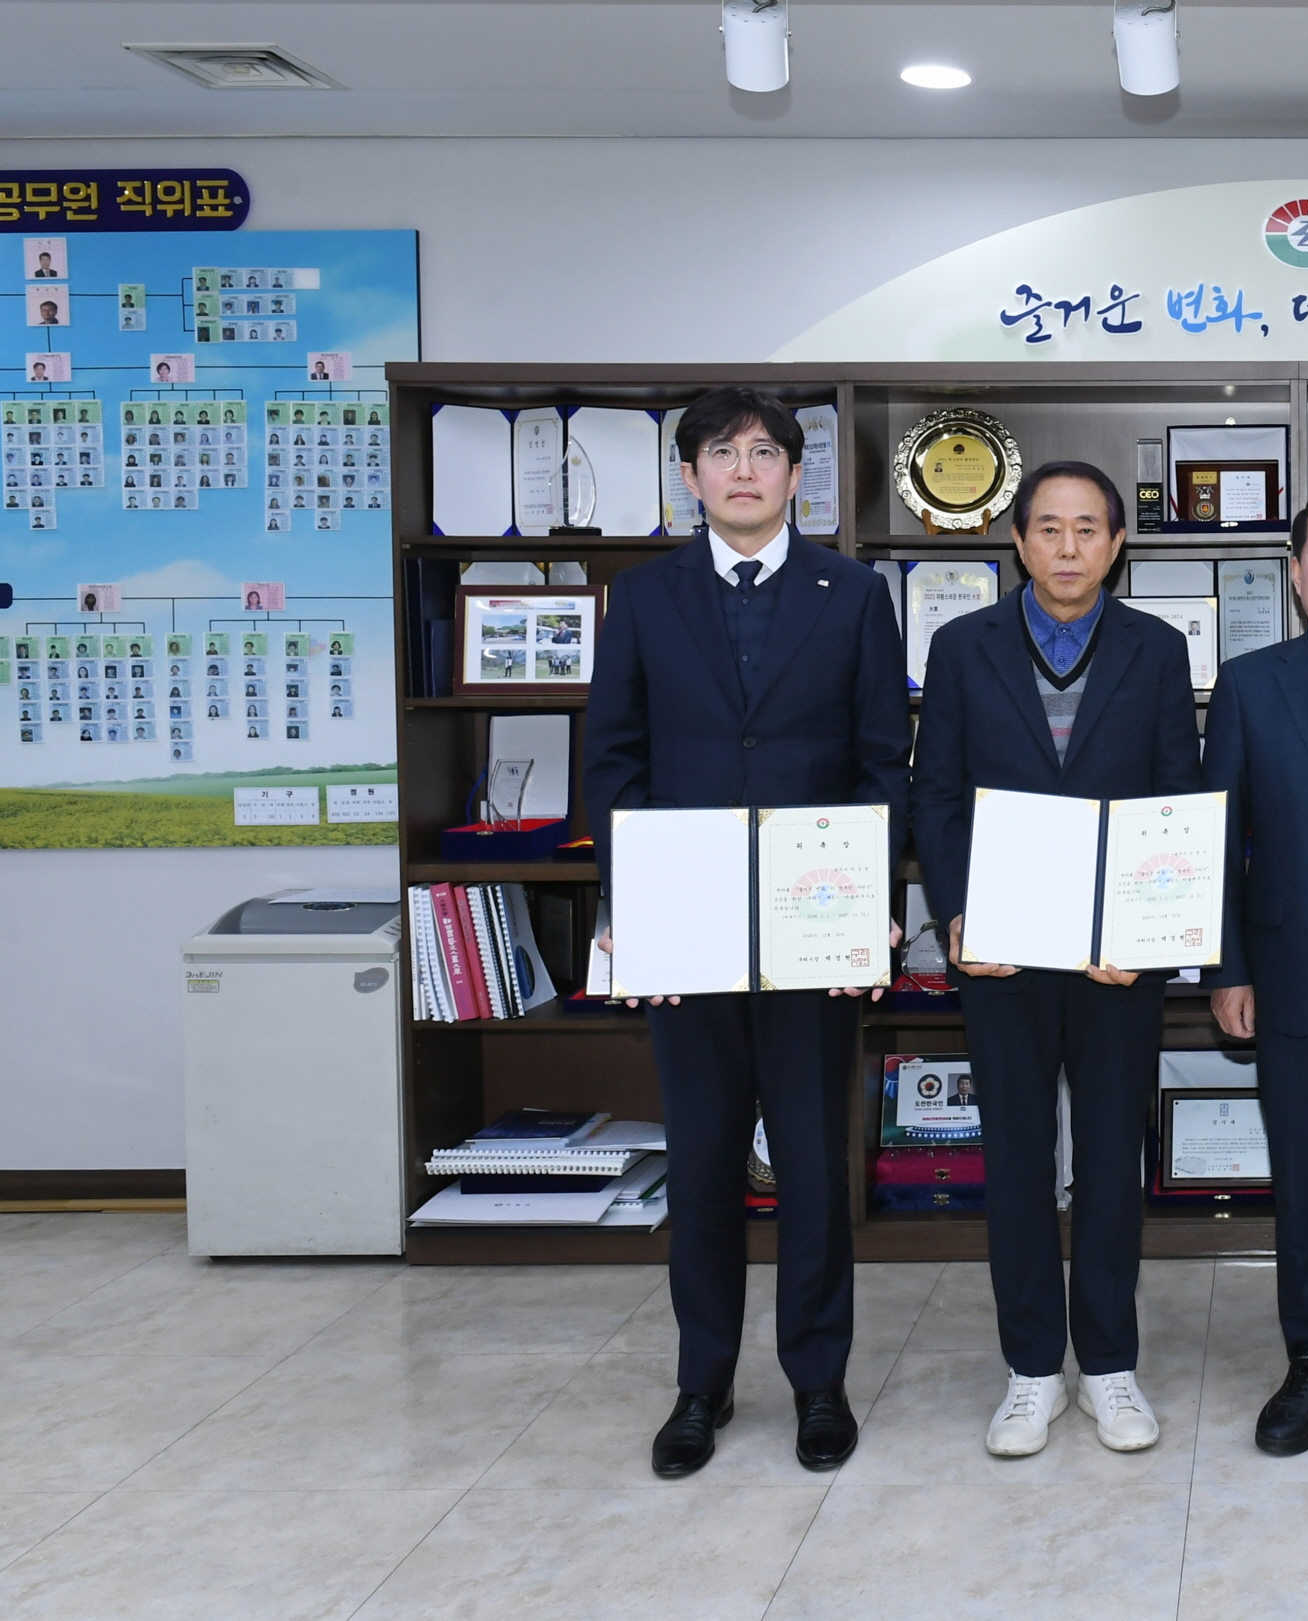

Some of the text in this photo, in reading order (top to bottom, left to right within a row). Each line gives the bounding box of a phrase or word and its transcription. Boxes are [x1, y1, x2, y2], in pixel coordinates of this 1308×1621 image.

[116, 180, 234, 218] 직위표
[1000, 284, 1142, 342] 즐거운
[1166, 283, 1269, 337] 변화,
